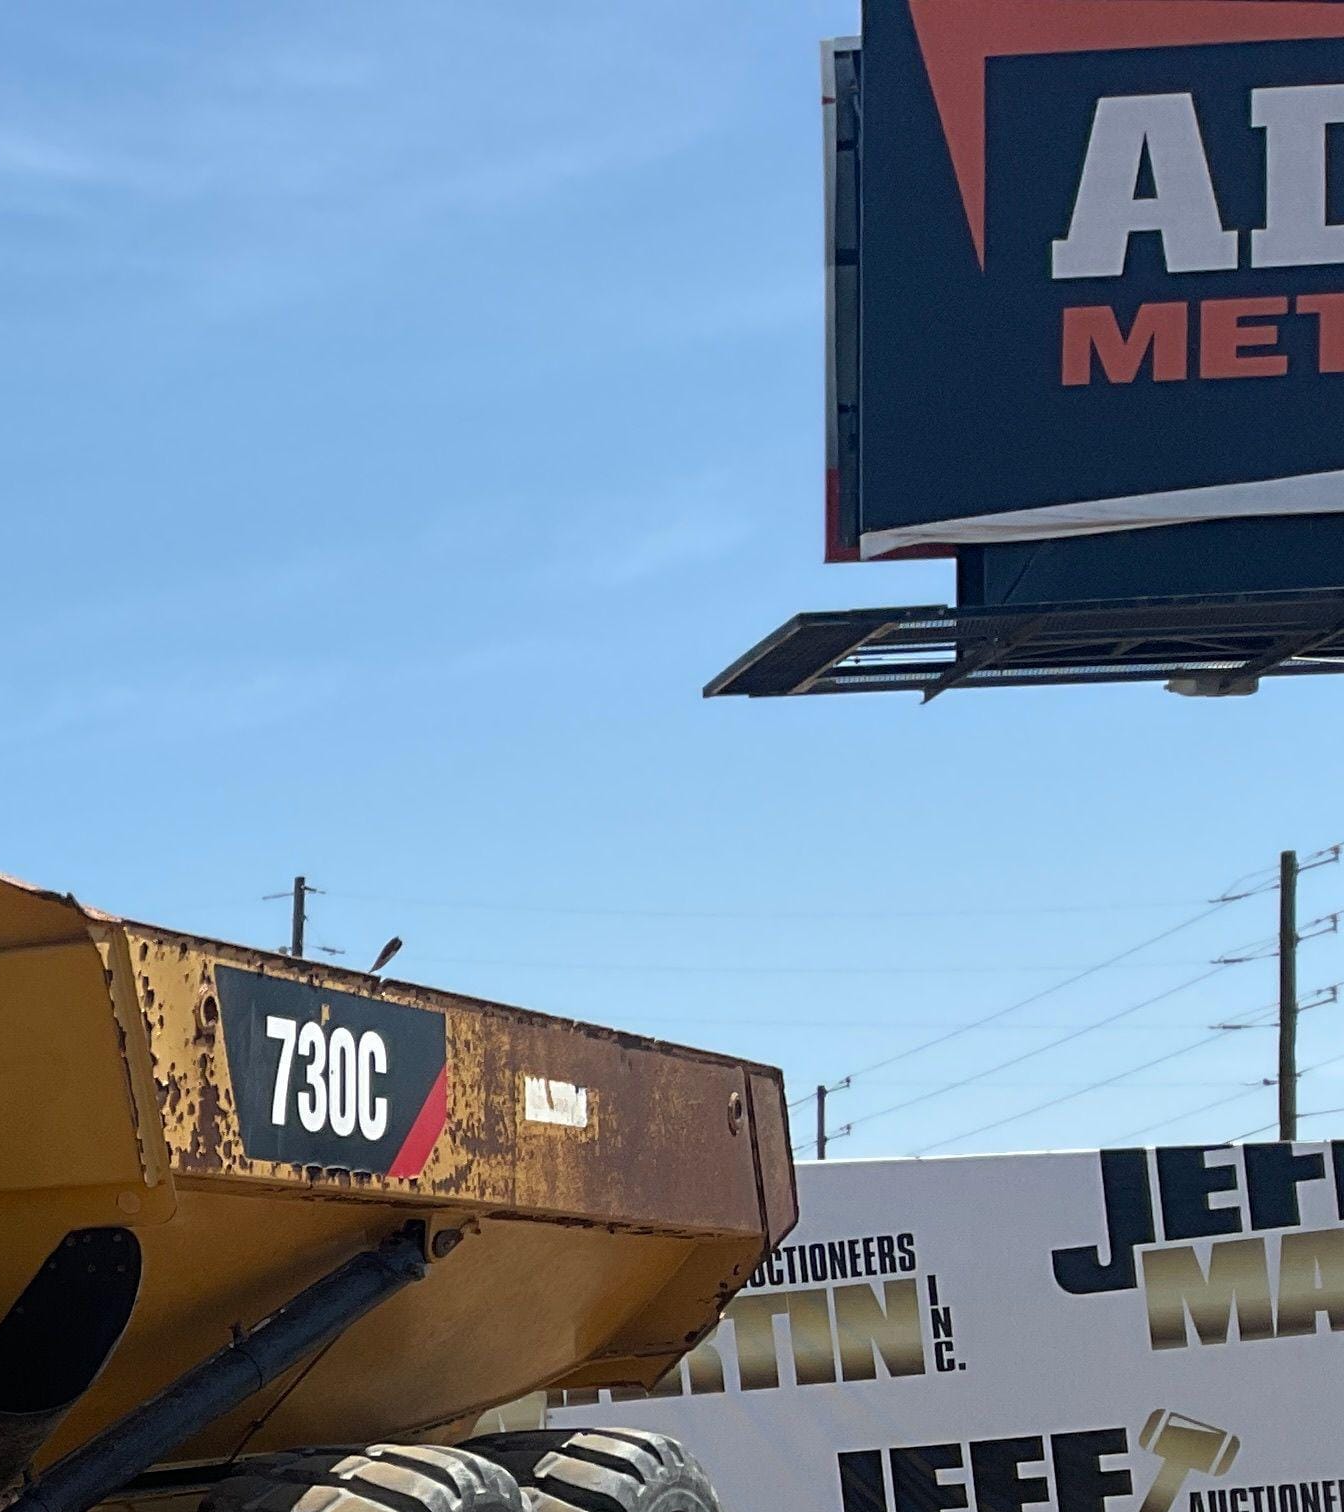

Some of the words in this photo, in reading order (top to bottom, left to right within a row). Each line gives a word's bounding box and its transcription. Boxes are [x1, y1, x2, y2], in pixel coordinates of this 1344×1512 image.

[266, 1014, 387, 1141] 730C
[742, 1232, 917, 1289] UCTIONEERS
[1052, 1139, 1344, 1295] JEF
[927, 1274, 967, 1373] INC.
